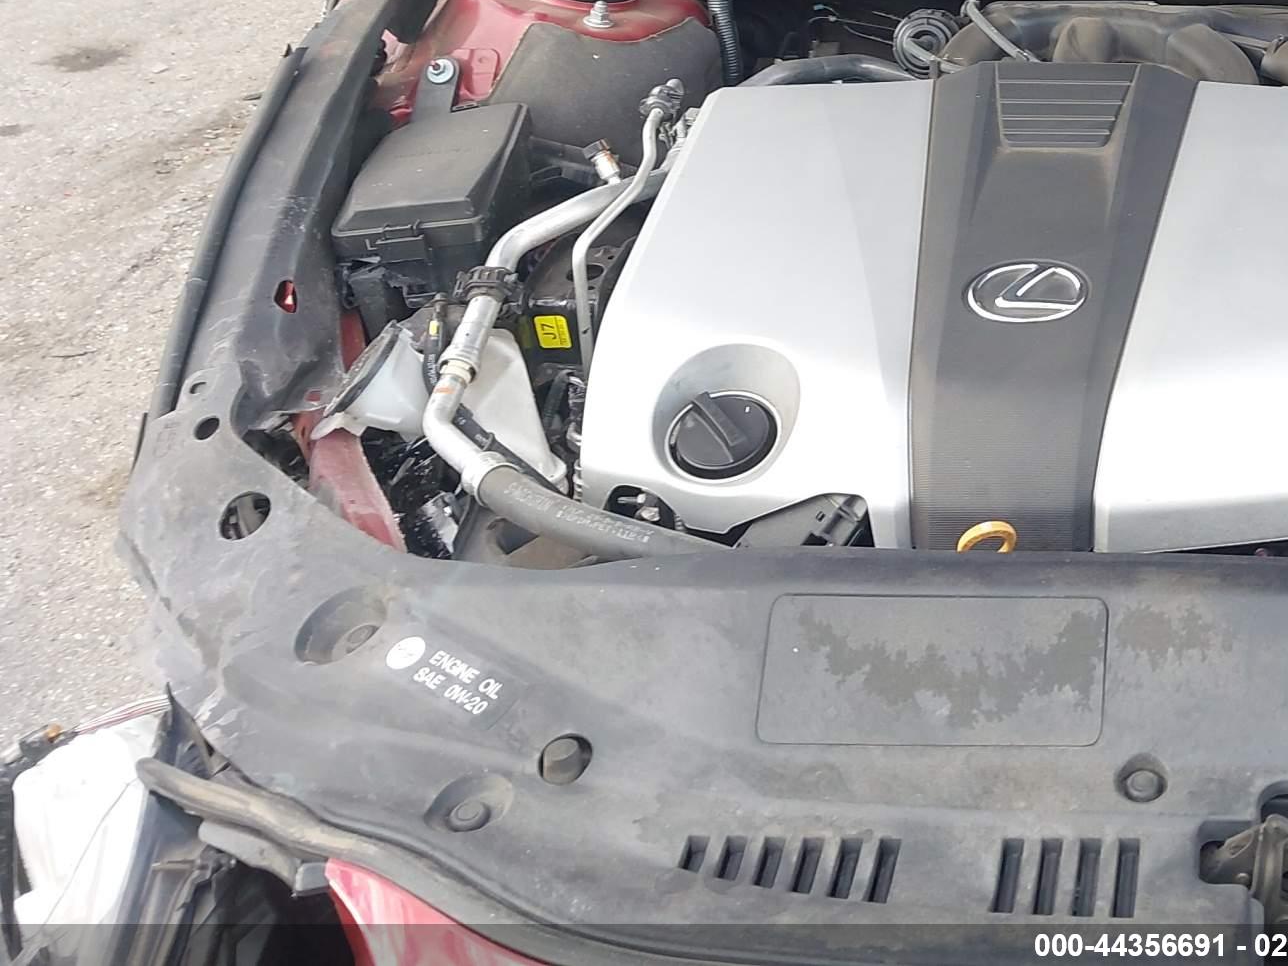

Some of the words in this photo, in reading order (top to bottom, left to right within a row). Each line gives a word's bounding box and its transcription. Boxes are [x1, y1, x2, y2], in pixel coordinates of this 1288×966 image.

[413, 667, 446, 689] SAE
[444, 684, 489, 715] 0W-20
[429, 650, 480, 684] ENGINE
[478, 678, 503, 700] OIL
